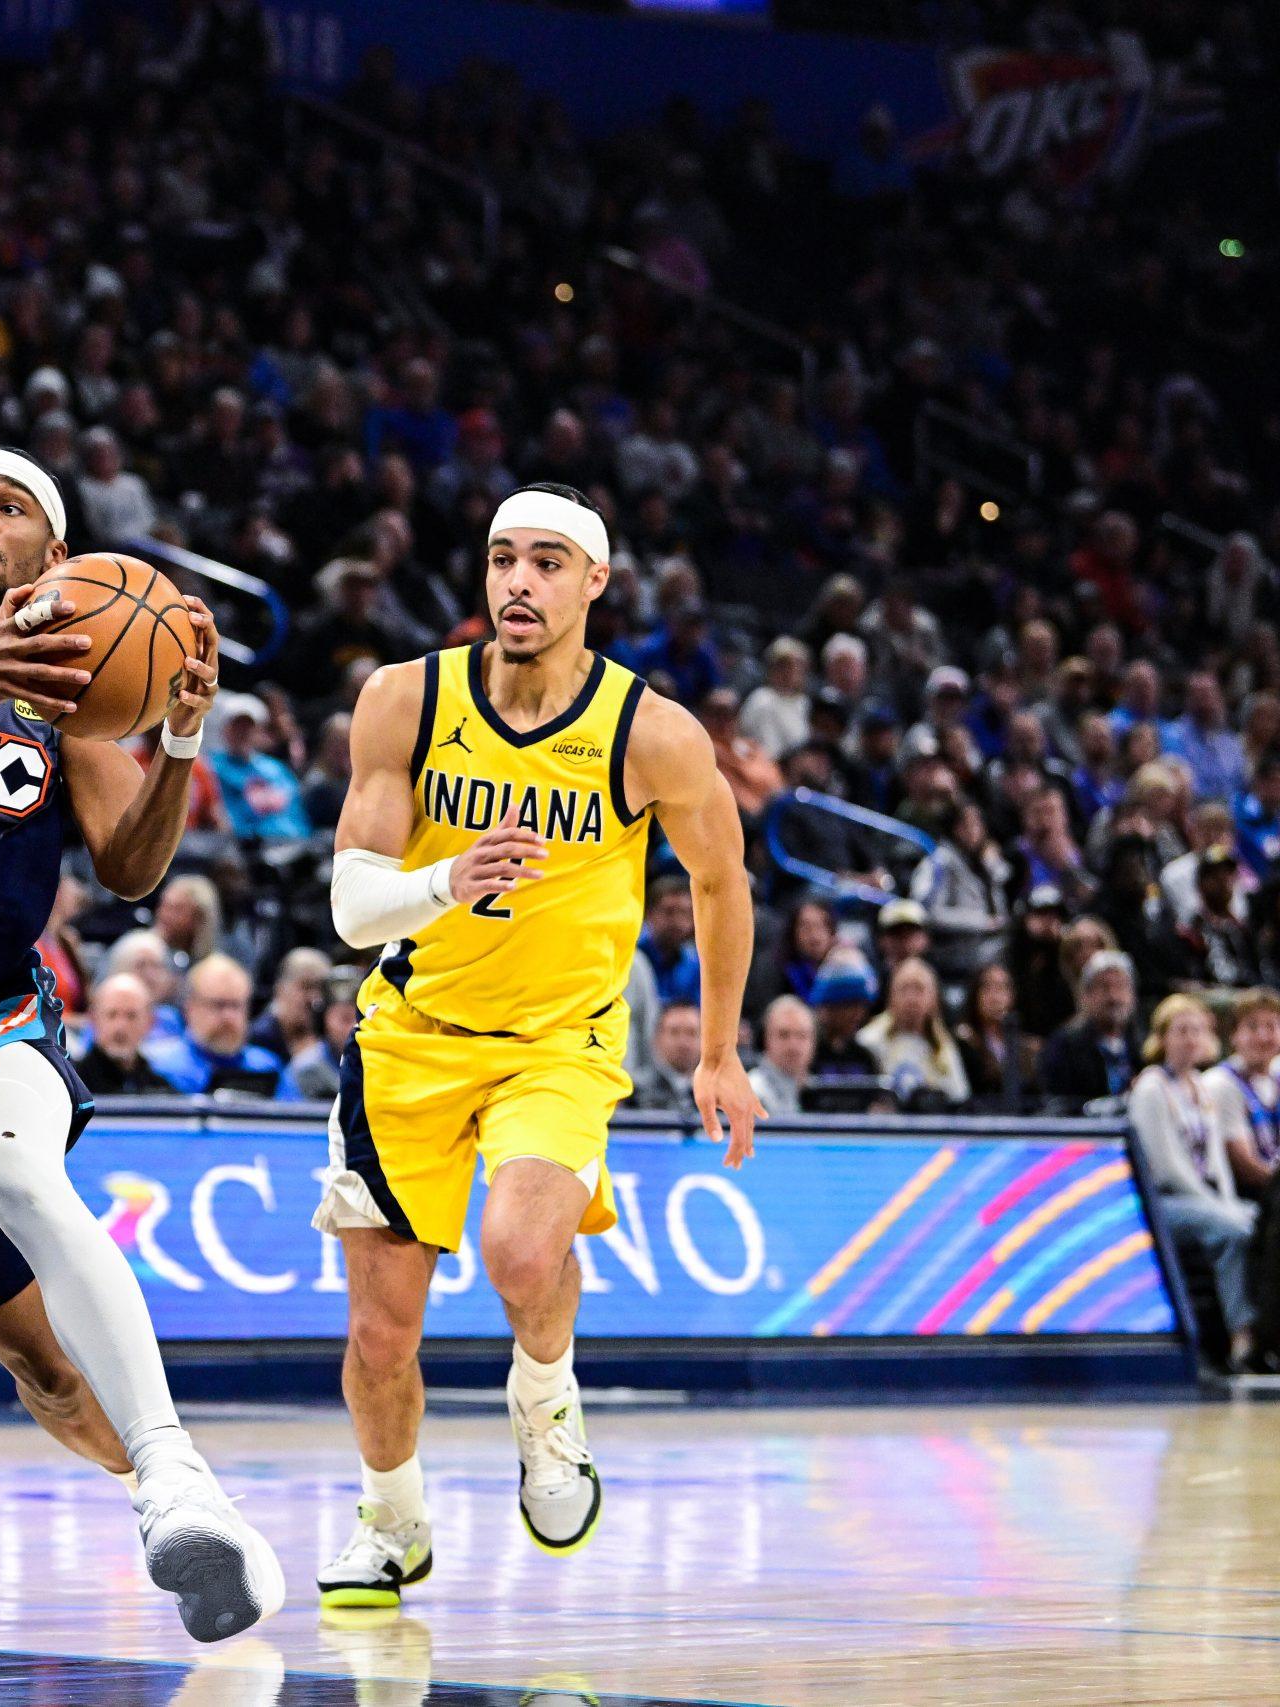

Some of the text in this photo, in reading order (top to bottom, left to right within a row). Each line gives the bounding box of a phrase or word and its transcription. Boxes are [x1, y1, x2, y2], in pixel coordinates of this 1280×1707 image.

[551, 742, 603, 758] LUCAS OIL
[423, 768, 603, 843] INDIANA
